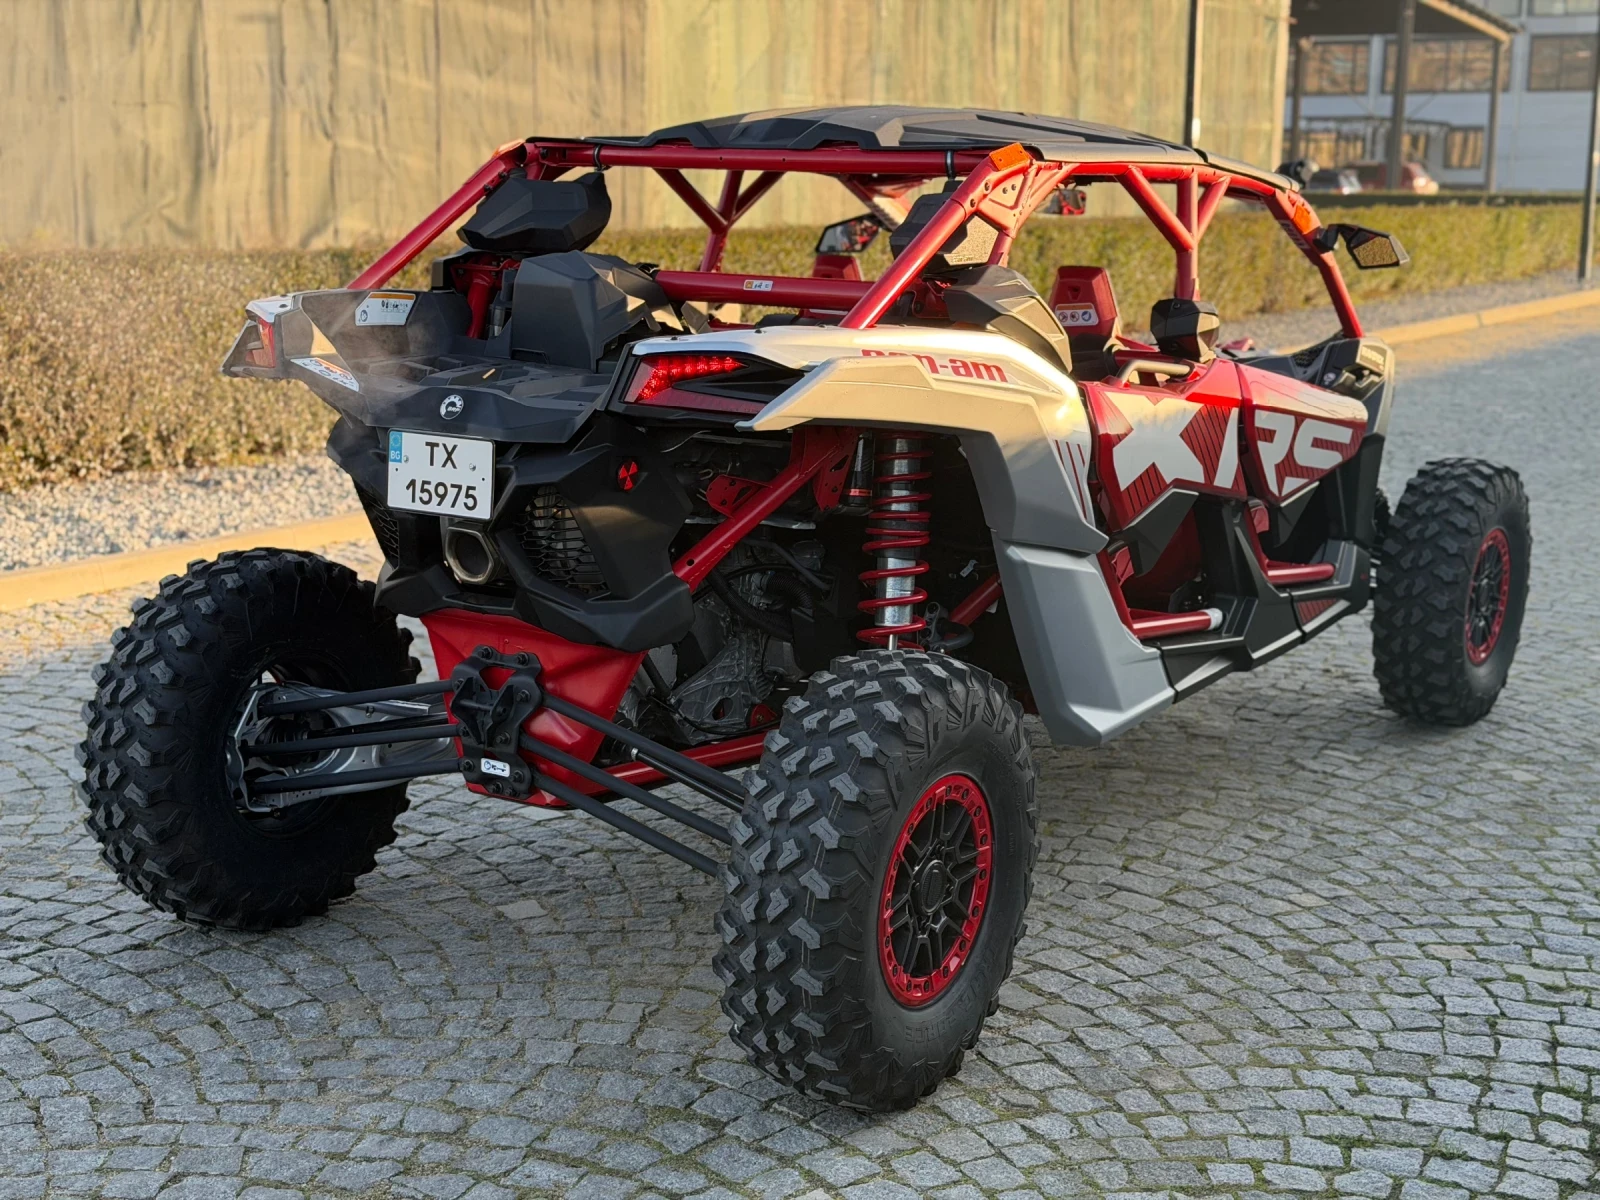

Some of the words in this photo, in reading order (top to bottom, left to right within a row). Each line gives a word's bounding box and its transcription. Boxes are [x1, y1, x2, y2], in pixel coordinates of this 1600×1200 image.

[861, 348, 1008, 383] n-am
[390, 450, 401, 460] BG
[425, 441, 458, 469] TX
[405, 478, 478, 511] 15975
